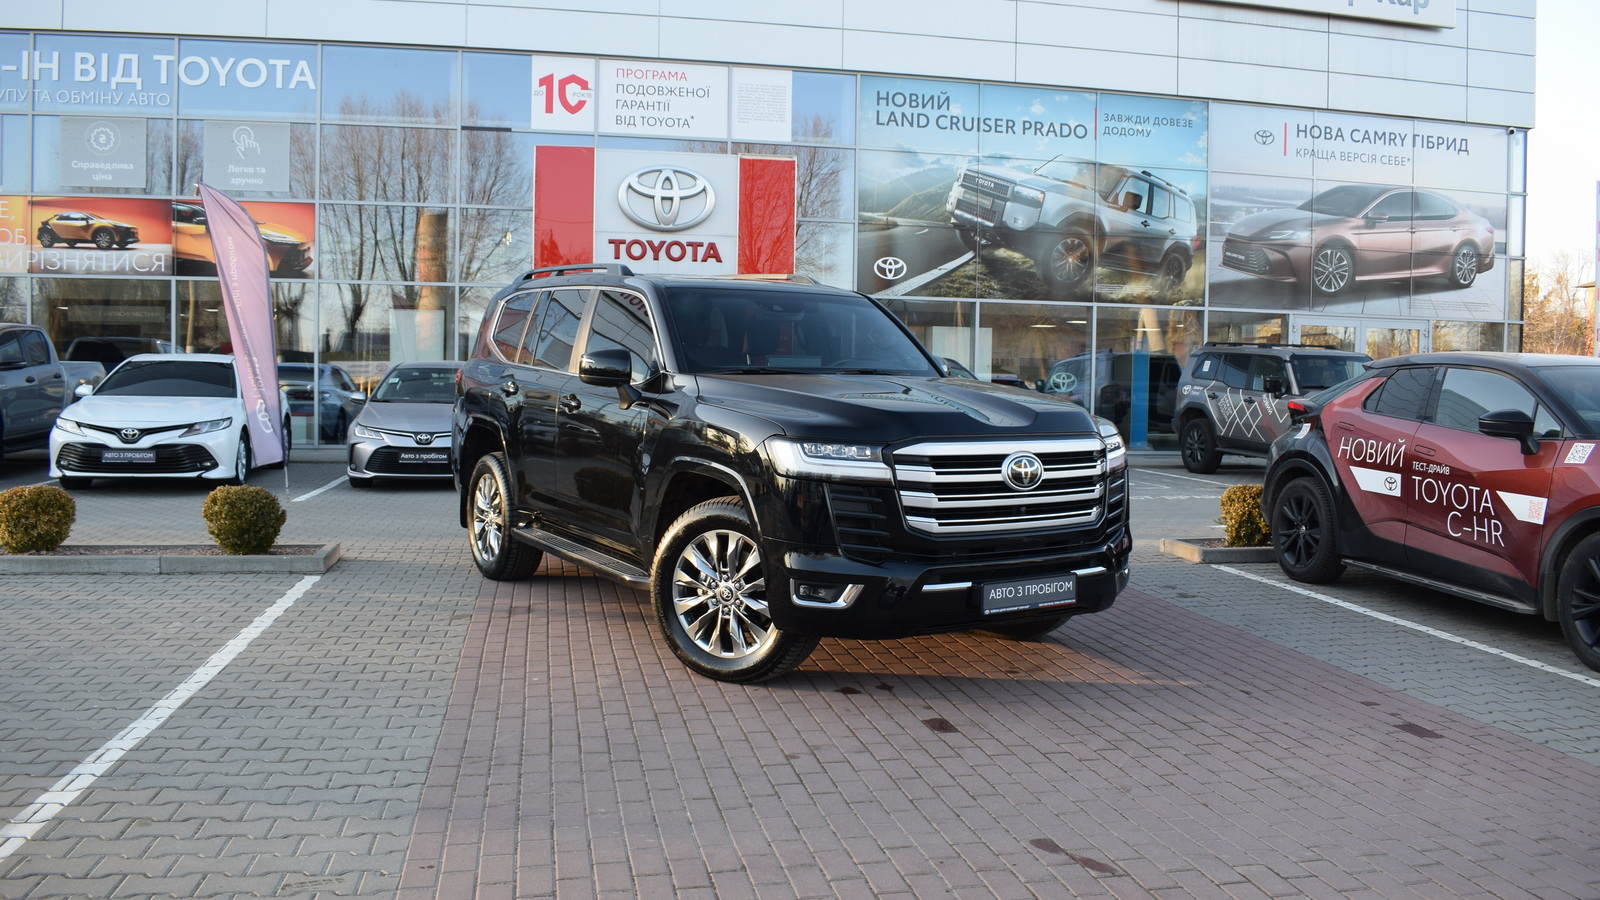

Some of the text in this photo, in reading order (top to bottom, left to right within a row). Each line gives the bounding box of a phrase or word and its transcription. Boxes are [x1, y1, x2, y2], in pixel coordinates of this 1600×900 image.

[75, 52, 143, 91] ВІД
[153, 54, 317, 90] TOYOTA
[616, 68, 688, 82] ПРОГРАМА
[33, 89, 52, 103] ТА
[56, 90, 123, 105] ОБМІНУ
[128, 92, 171, 107] АВТО
[616, 83, 711, 99] ПОДОВЖЕНОЇ
[615, 99, 670, 113] ГАРАНТІЇ
[876, 90, 950, 110] НОВИЙ
[615, 115, 637, 128] ВІД
[875, 110, 1088, 139] LAND CRUISER PRADO
[1103, 113, 1194, 129] ЗАВЖДИ ДОВЕЗЕ
[1102, 126, 1152, 138] ДОДОМУ
[1296, 124, 1470, 156] НОВА CAMRY ГІБРИД
[1296, 148, 1337, 162] КРАЩА
[1340, 151, 1377, 164] ВЕРСІЯ
[71, 160, 134, 172] Справедлива
[227, 165, 266, 175] Легко та
[92, 173, 112, 182] ціна
[230, 177, 264, 187] зручно
[975, 179, 995, 188] TOYOTA
[608, 239, 722, 263] TOYOTA
[0, 250, 165, 272] ИРІЗНЯТИСЯ
[1337, 436, 1406, 468] НОВИЙ
[1412, 461, 1450, 476] ТЕСТ-ДРАЙВ
[1412, 475, 1495, 516] TOYOTA
[1447, 511, 1505, 547] C-HR
[988, 581, 1073, 599] АВТО З ПРОБІГОМ
